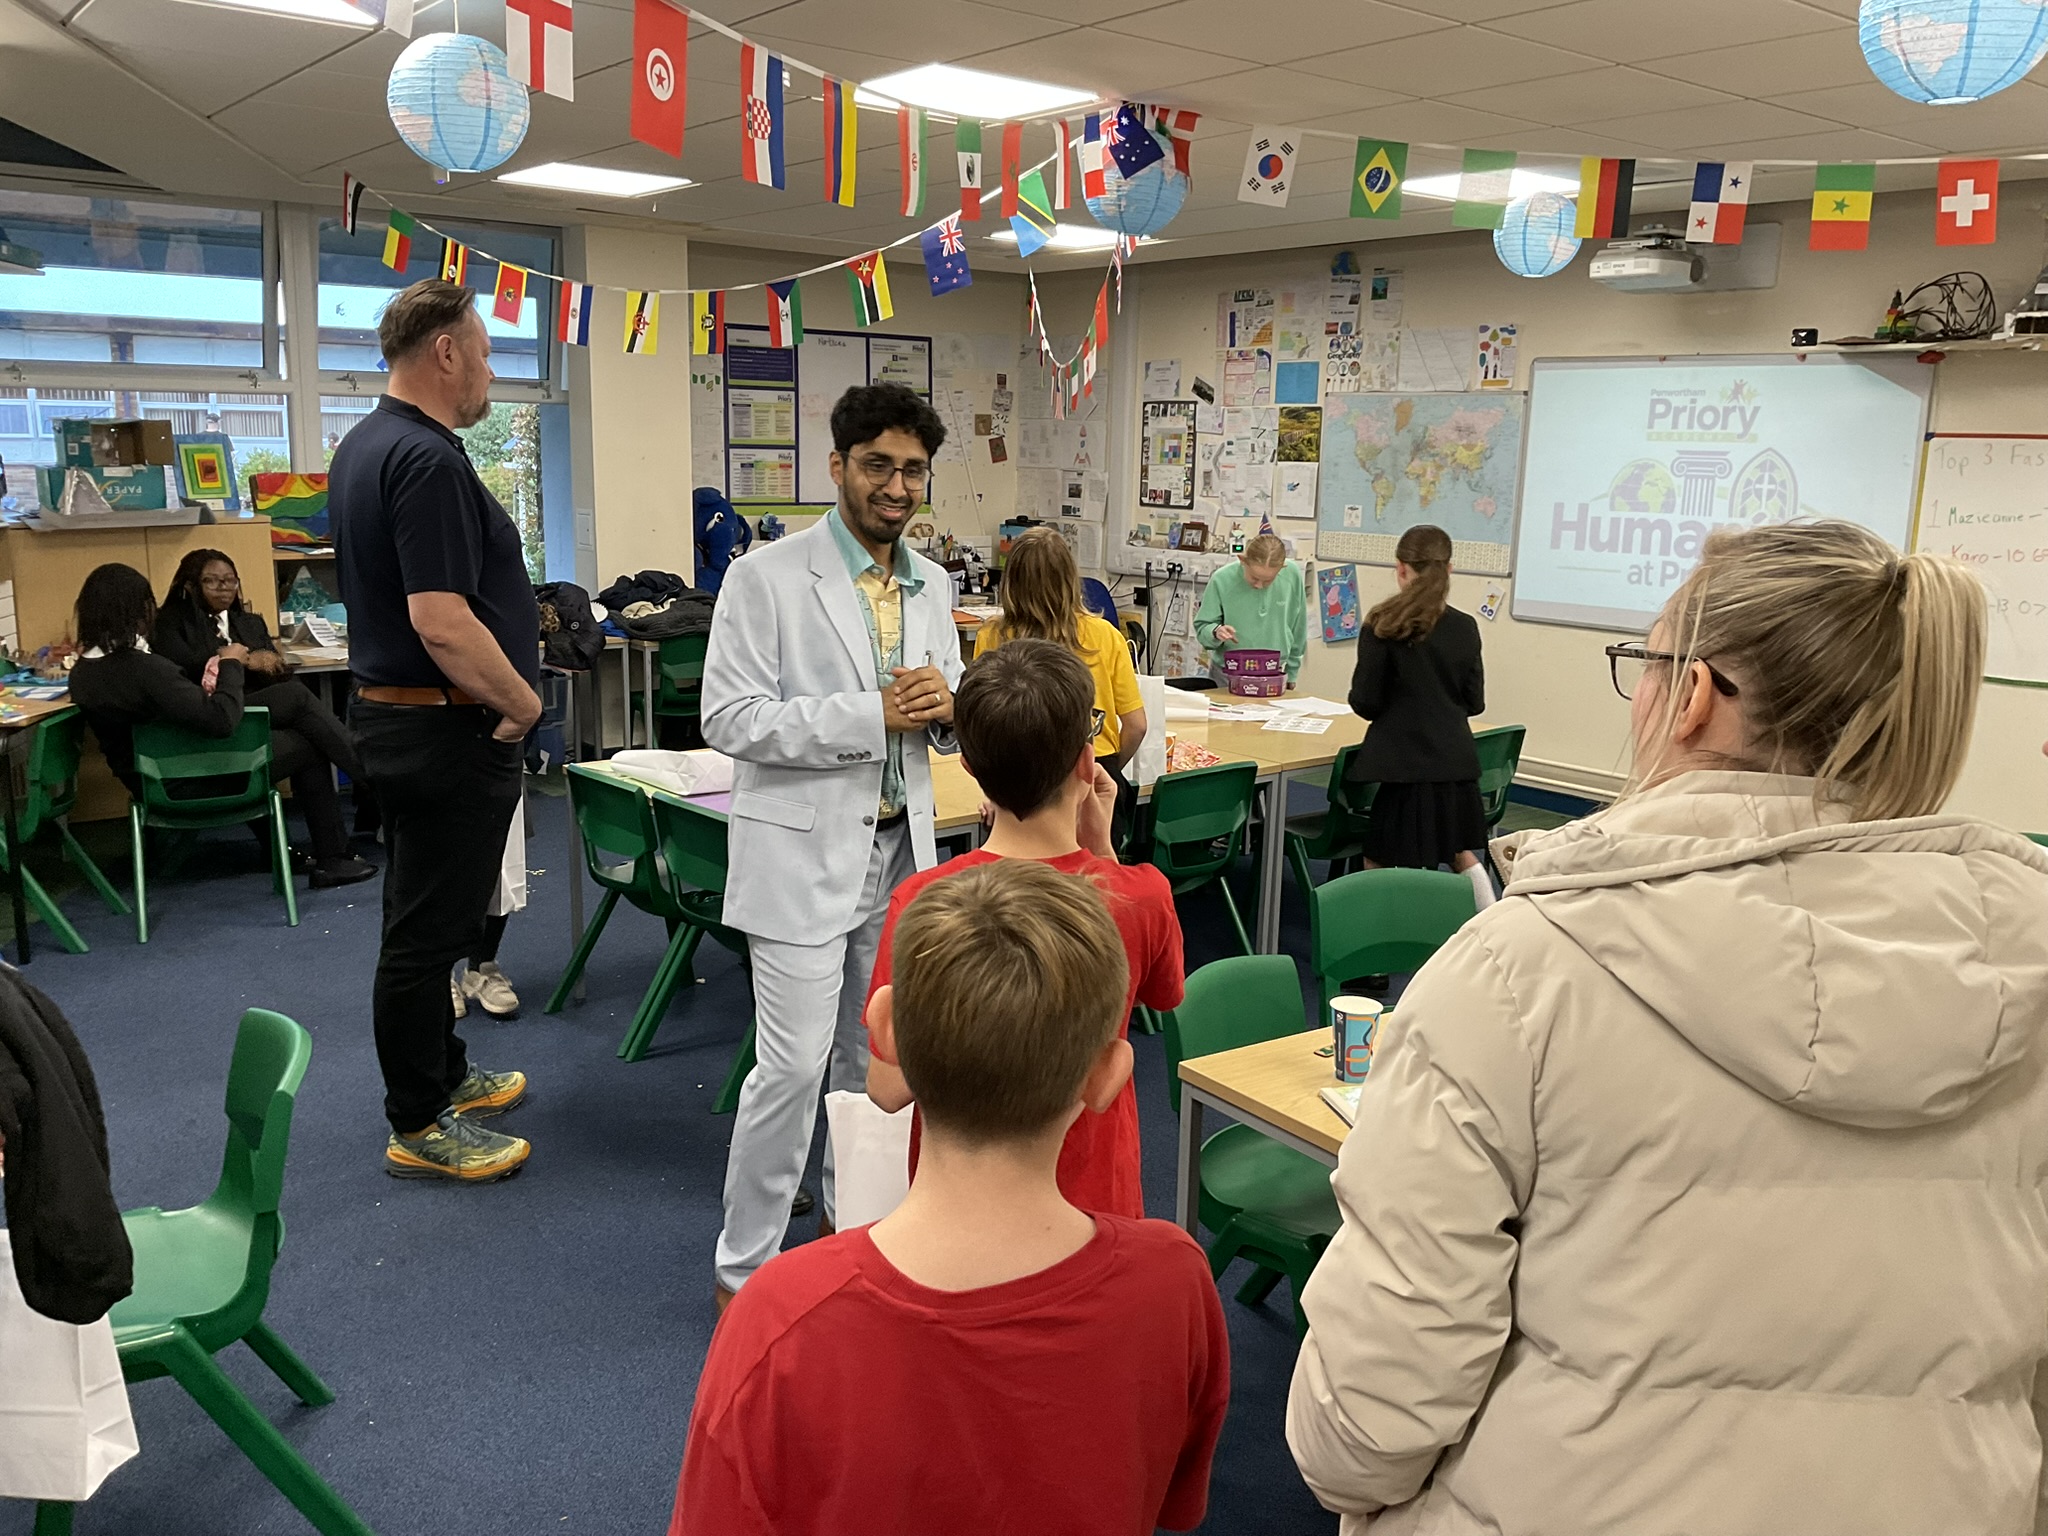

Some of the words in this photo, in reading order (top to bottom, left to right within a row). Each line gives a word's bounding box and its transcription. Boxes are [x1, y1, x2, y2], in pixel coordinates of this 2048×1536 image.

[817, 337, 847, 348] Notices
[1647, 398, 1761, 439] Priory
[1934, 442, 1970, 476] Top
[1982, 443, 1993, 466] 3
[106, 485, 142, 495] PAPER
[1626, 560, 1654, 586] at
